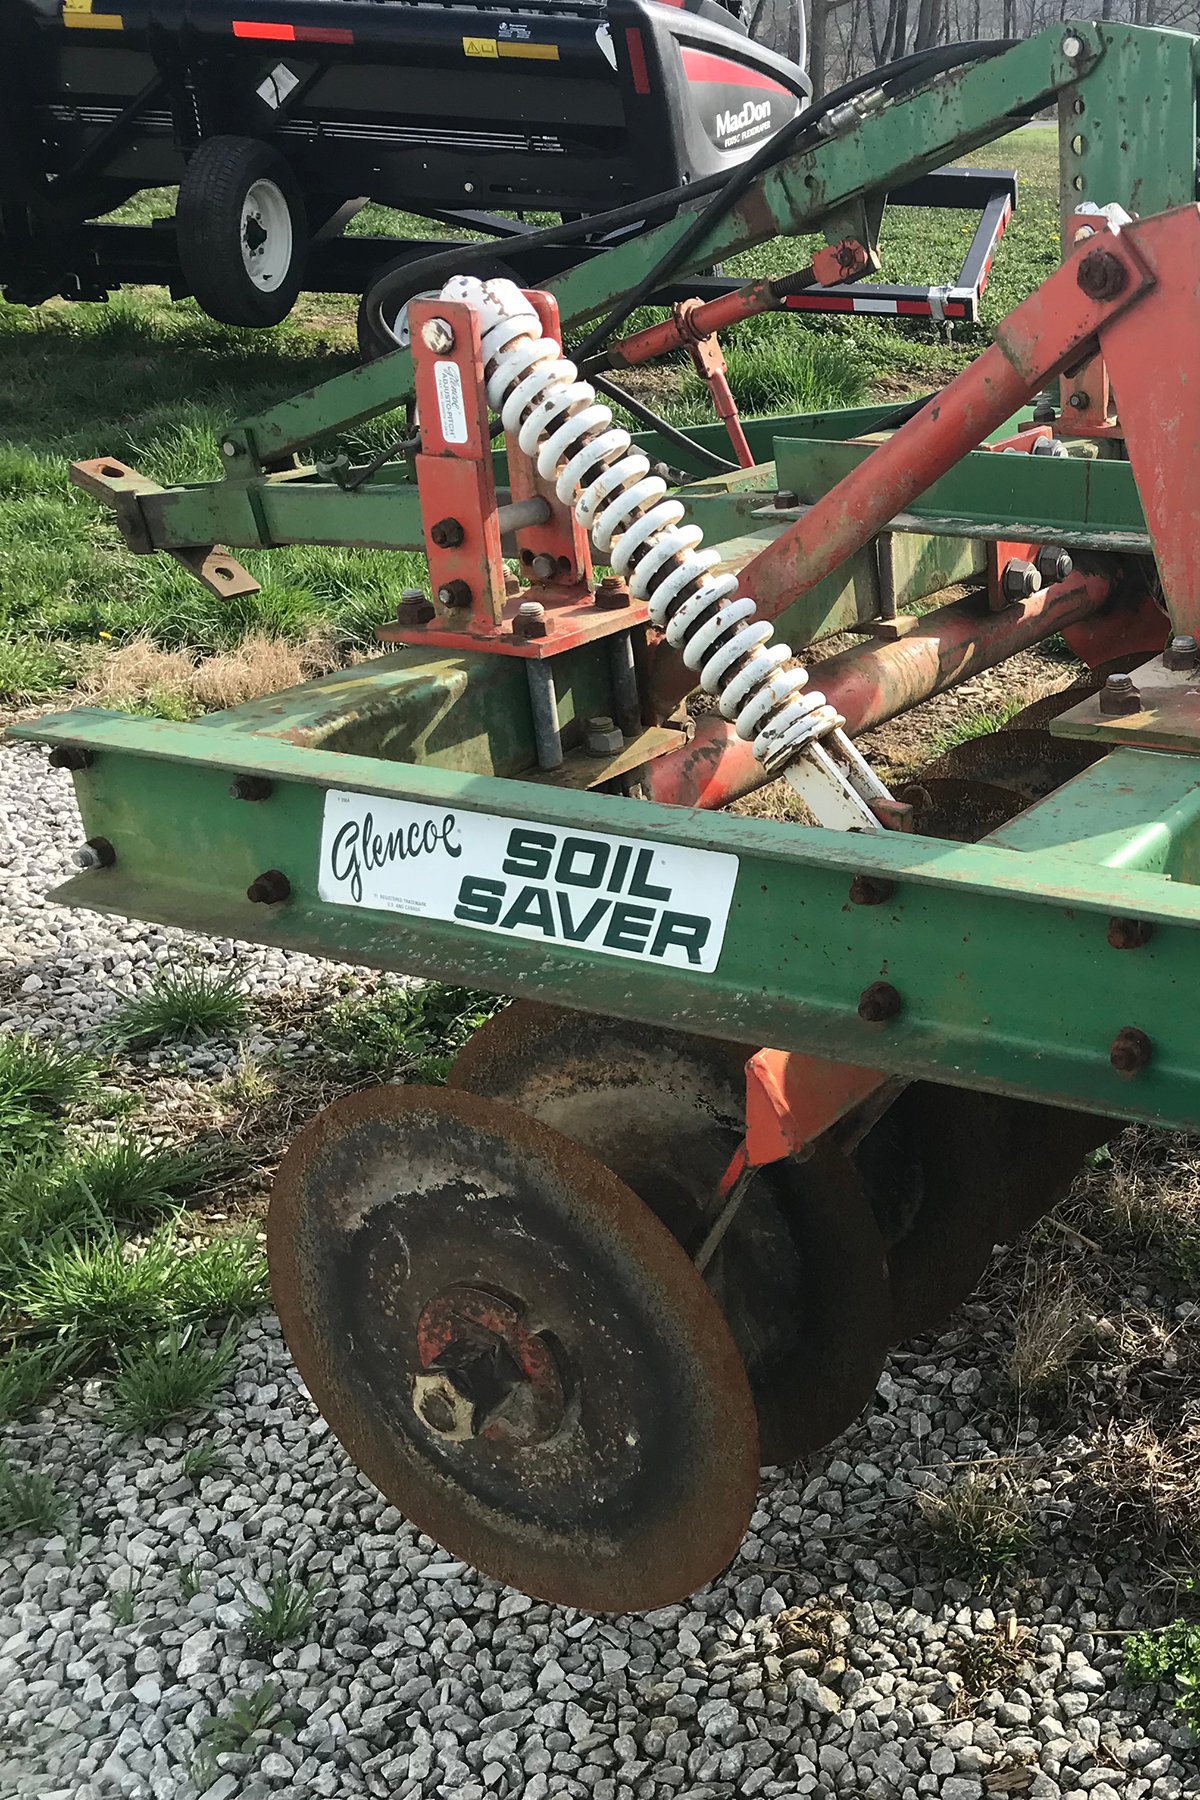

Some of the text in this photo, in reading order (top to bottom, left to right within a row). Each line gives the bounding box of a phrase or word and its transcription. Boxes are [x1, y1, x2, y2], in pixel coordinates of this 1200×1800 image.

[716, 100, 771, 138] MacDon
[331, 812, 462, 903] Glencoe
[502, 827, 673, 903] SOIL
[453, 875, 712, 965] SAVER
